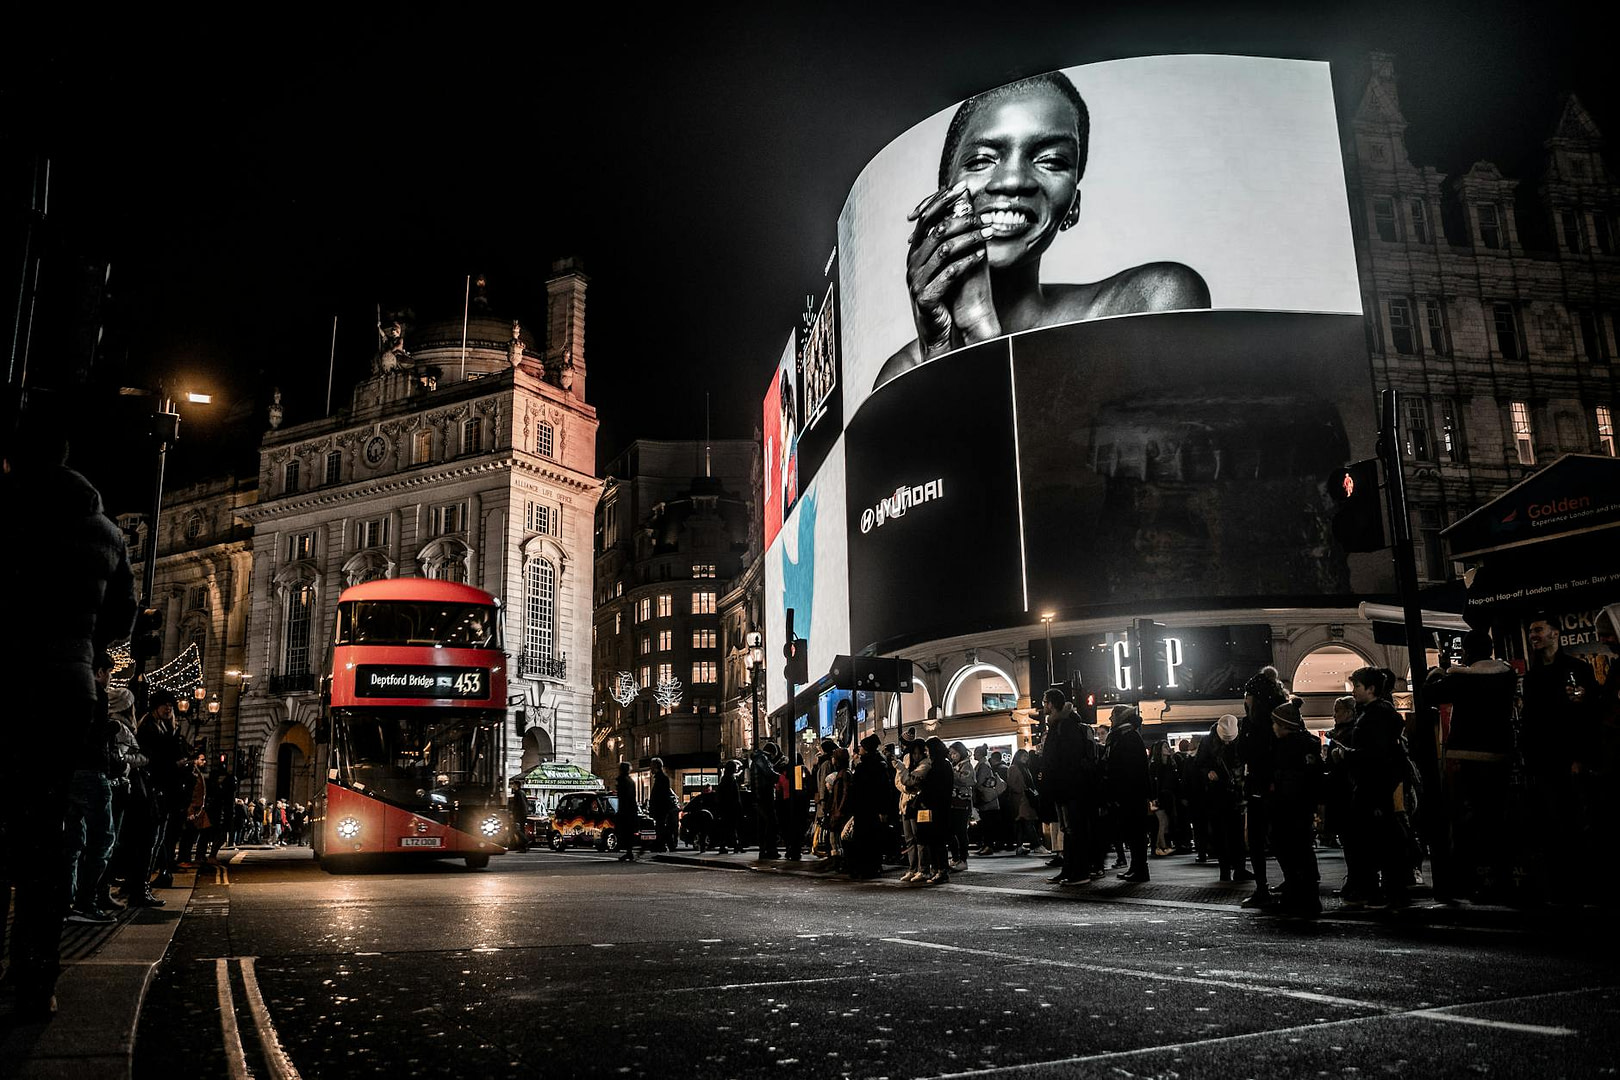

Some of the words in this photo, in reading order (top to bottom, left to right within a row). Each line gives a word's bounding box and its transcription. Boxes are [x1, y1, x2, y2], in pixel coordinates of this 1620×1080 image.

[515, 480, 538, 492] ALLIANCE
[542, 488, 553, 497] LIFE
[557, 494, 573, 503] OFFICE
[876, 479, 943, 527] HYUNDAI
[1528, 496, 1590, 519] Golden
[1531, 515, 1568, 528] Experience
[1569, 509, 1594, 519] London
[1468, 596, 1495, 606] Hop-on
[1496, 589, 1523, 601] Hop-off
[1525, 585, 1552, 596] London
[1554, 582, 1569, 591] Bus
[1570, 579, 1590, 588] Tour.
[1591, 576, 1607, 584] Buy
[1560, 632, 1591, 647] BEAT
[1113, 637, 1183, 691] GP
[370, 673, 407, 688] Deptford
[408, 674, 435, 688] Bridge
[453, 672, 481, 695] 453
